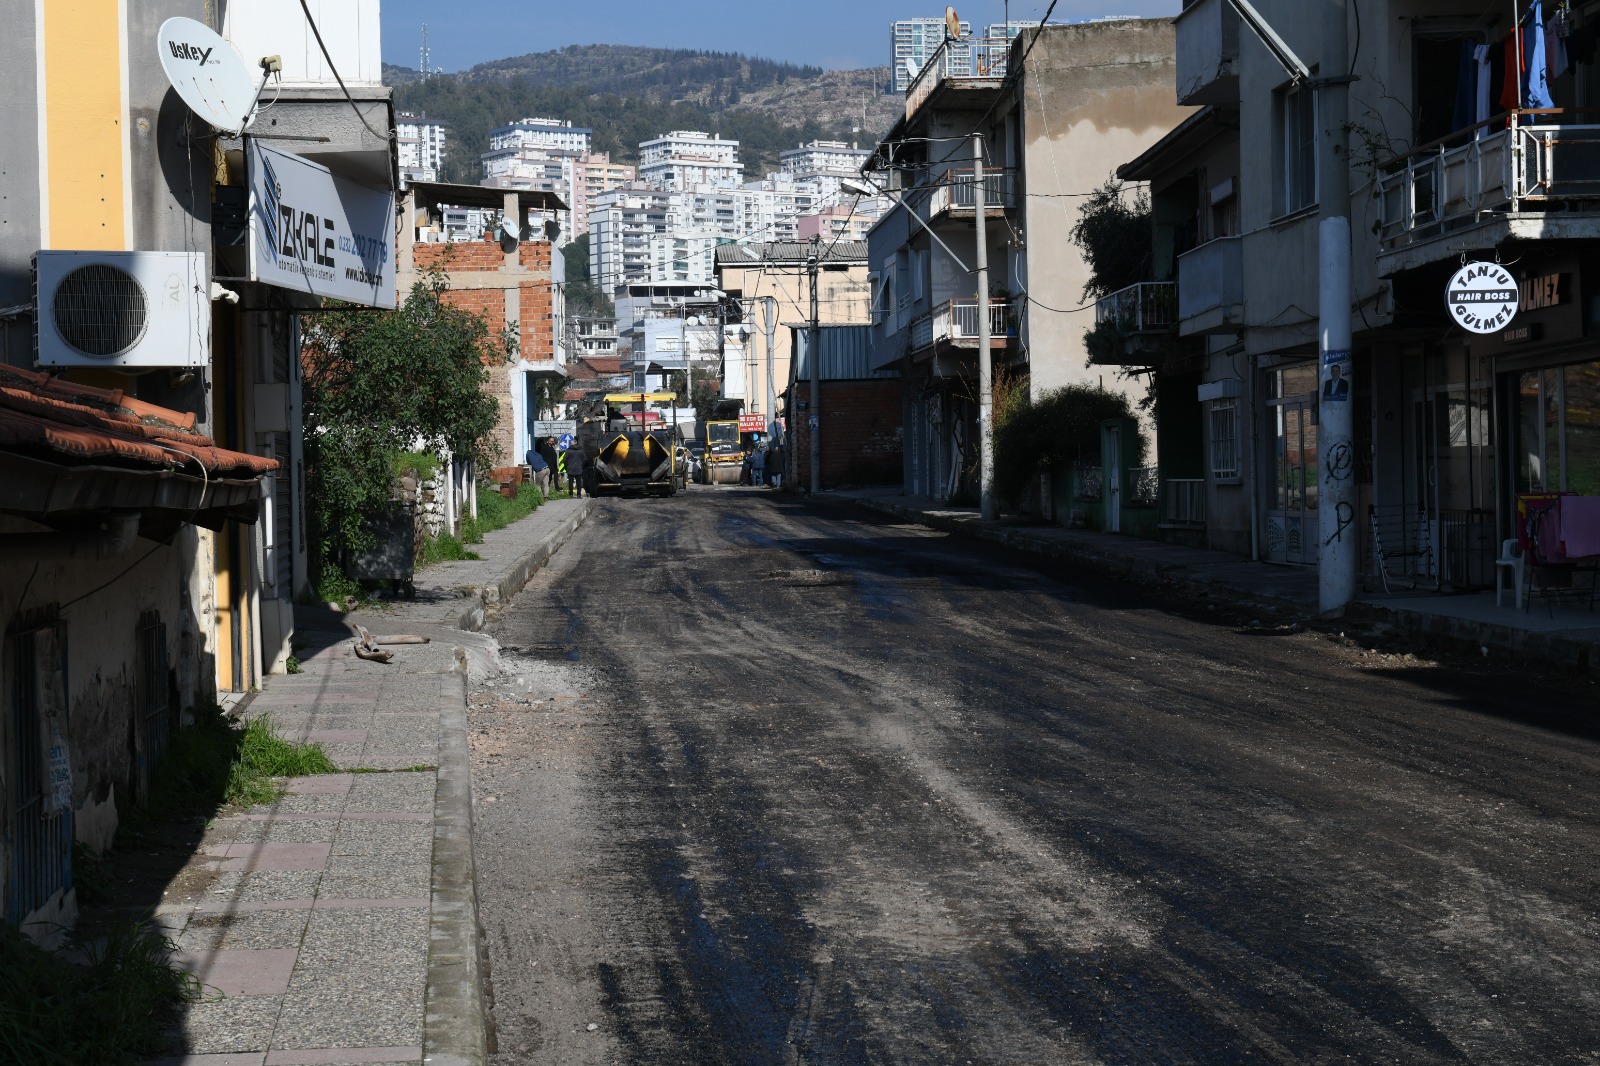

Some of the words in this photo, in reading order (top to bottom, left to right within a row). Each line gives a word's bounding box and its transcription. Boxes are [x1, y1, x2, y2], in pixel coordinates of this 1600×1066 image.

[168, 40, 213, 67] UsKey
[351, 232, 366, 258] 202
[367, 237, 378, 261] 77
[1457, 265, 1509, 288] TANJU
[1456, 292, 1482, 301] HAIR
[1484, 292, 1511, 300] BOSS
[1455, 303, 1513, 331] GÜLMEZ
[1515, 327, 1528, 340] BOSS
